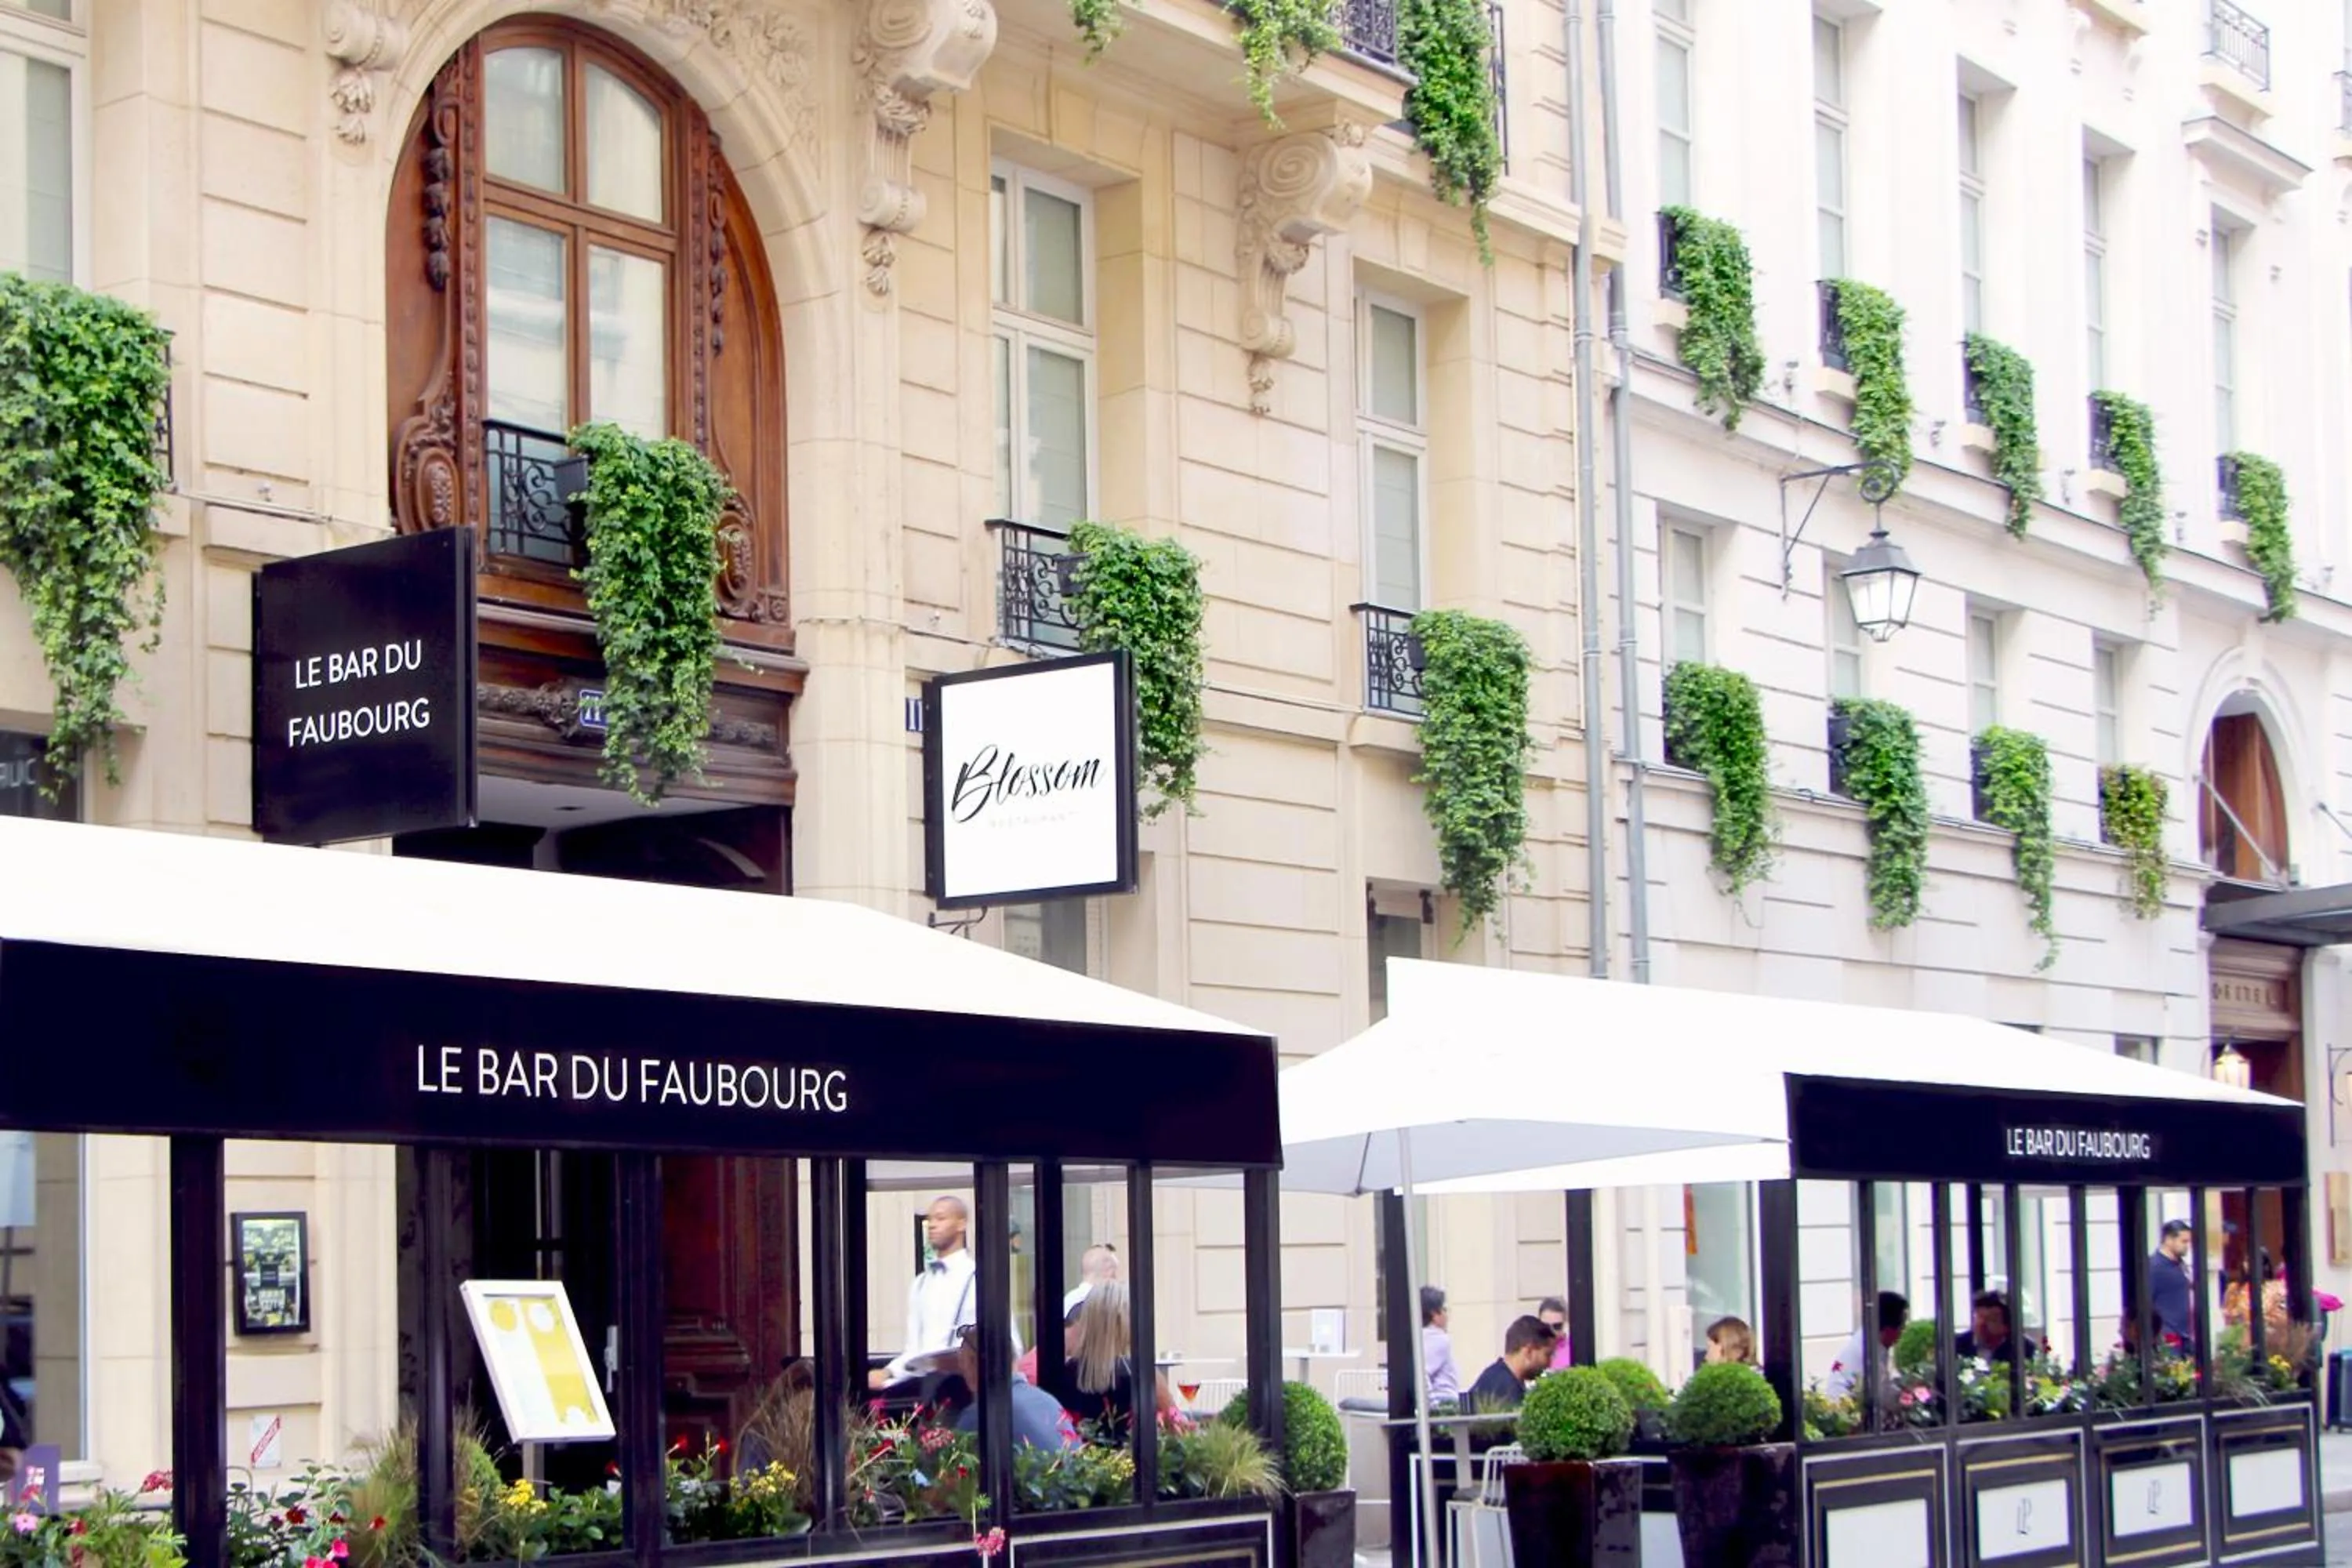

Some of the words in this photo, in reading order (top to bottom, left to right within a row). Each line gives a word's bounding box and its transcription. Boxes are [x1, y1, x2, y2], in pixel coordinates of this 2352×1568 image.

[296, 655, 322, 689] LE
[328, 648, 378, 684] BAR
[385, 639, 422, 674] DU
[288, 697, 430, 748] FAUBOURG
[951, 744, 1105, 823] Blossom
[417, 1044, 463, 1094] LE
[477, 1048, 558, 1098] BAR
[572, 1054, 627, 1102] DU
[641, 1059, 848, 1113] FAUBOURG
[2006, 1127, 2024, 1156] LE
[2026, 1128, 2053, 1156] BAR
[2056, 1129, 2076, 1156] DU
[2078, 1131, 2151, 1159] FAUBOURG
